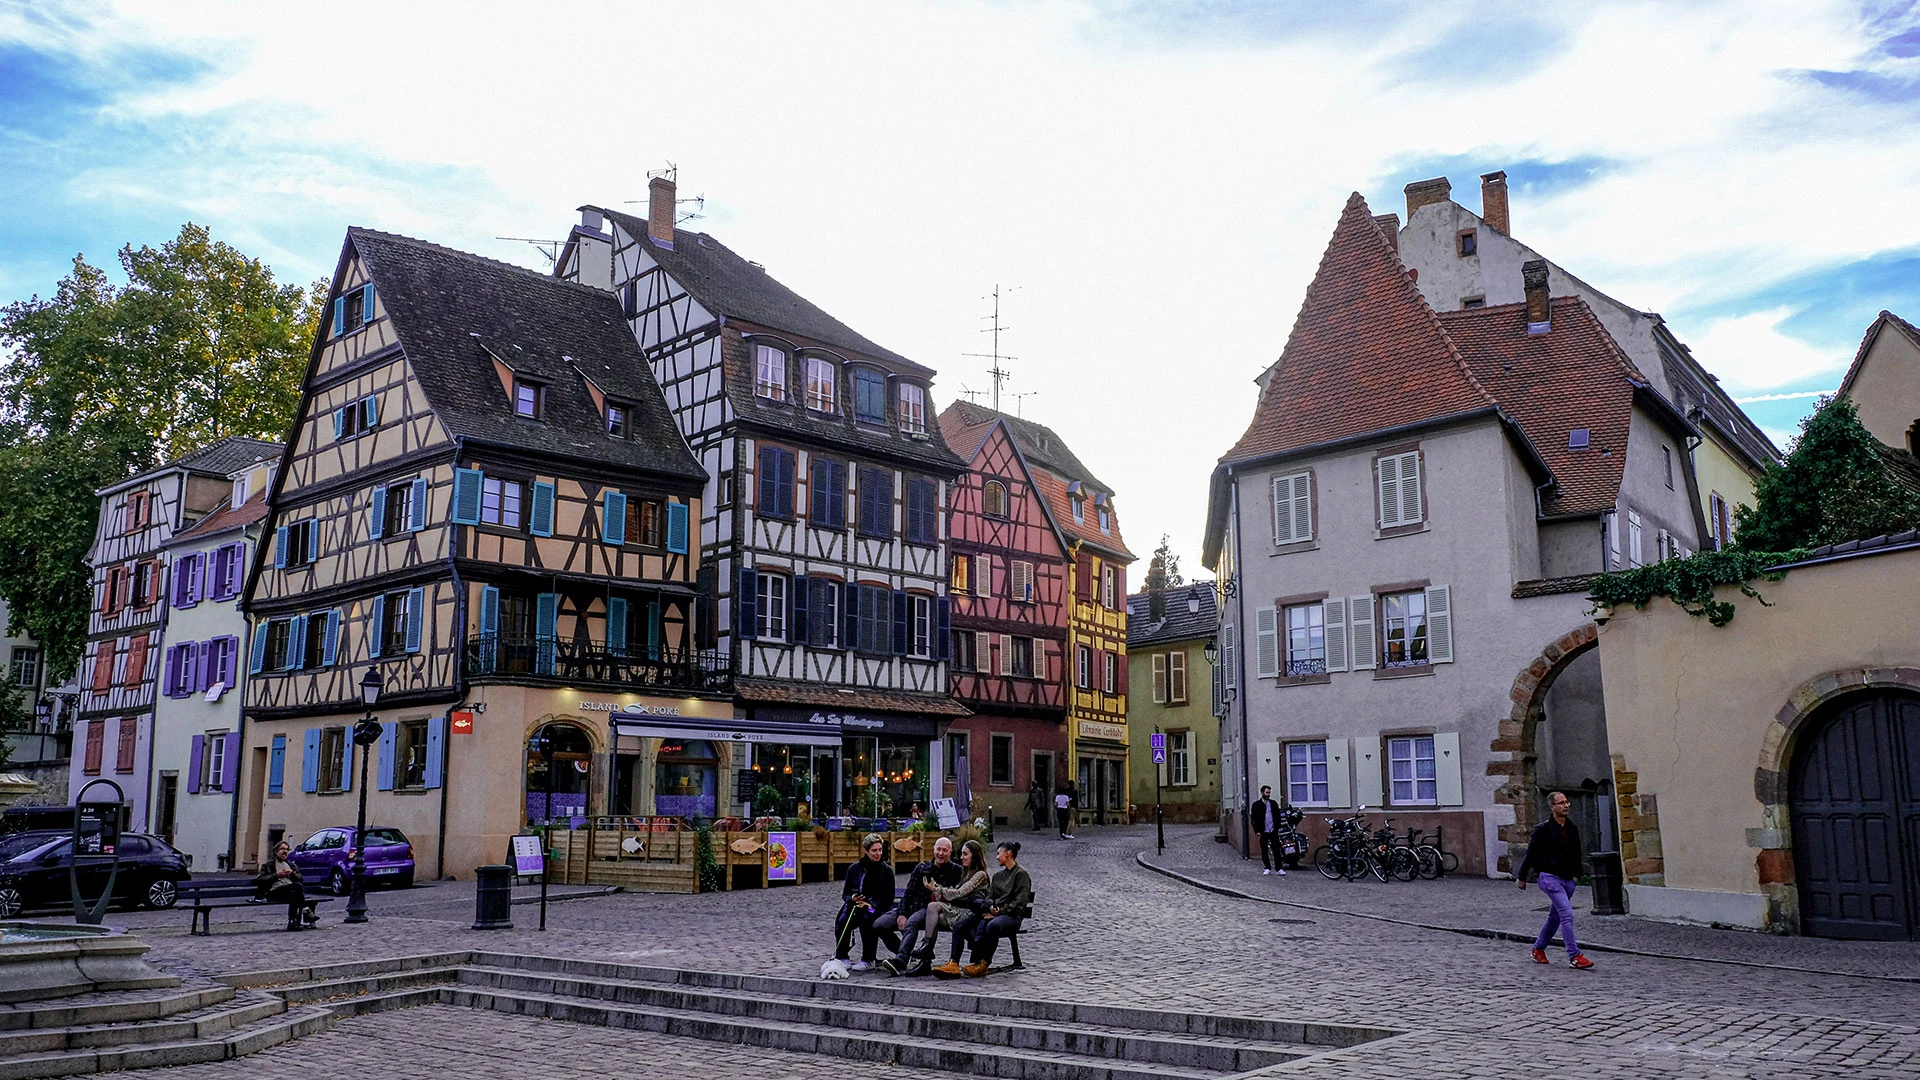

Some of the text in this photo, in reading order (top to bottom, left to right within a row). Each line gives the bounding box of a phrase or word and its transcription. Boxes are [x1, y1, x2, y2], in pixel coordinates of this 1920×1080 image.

[579, 702, 680, 715] ISLAND POKÉ
[1082, 724, 1101, 735] Librairie
